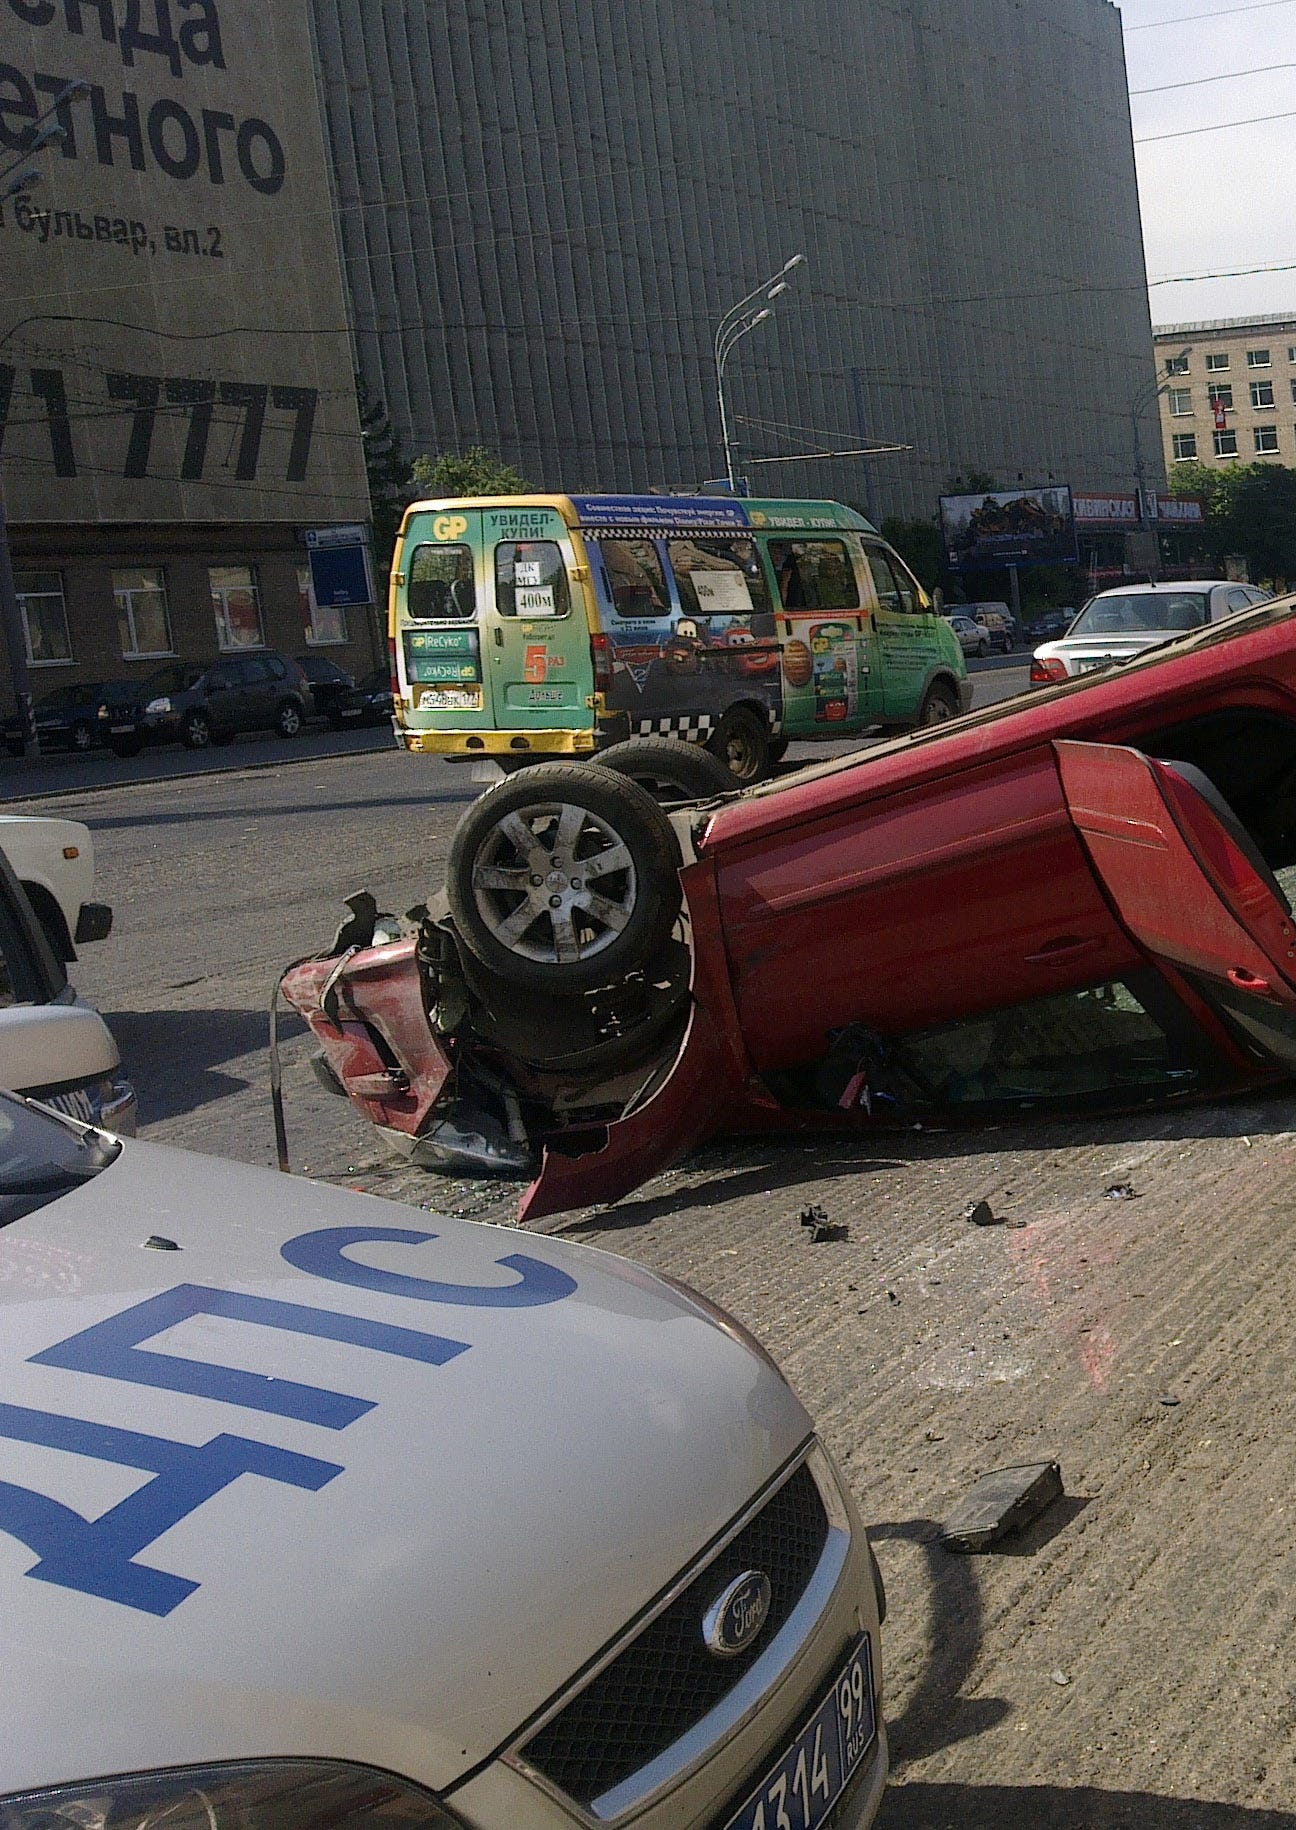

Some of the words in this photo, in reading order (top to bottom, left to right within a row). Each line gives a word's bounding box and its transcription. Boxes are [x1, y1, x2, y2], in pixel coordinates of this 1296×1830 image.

[433, 516, 468, 541] GP
[501, 527, 545, 539] КУПИ!
[524, 645, 547, 685] 5
[732, 1588, 763, 1638] Ford
[840, 1661, 863, 1740] 99
